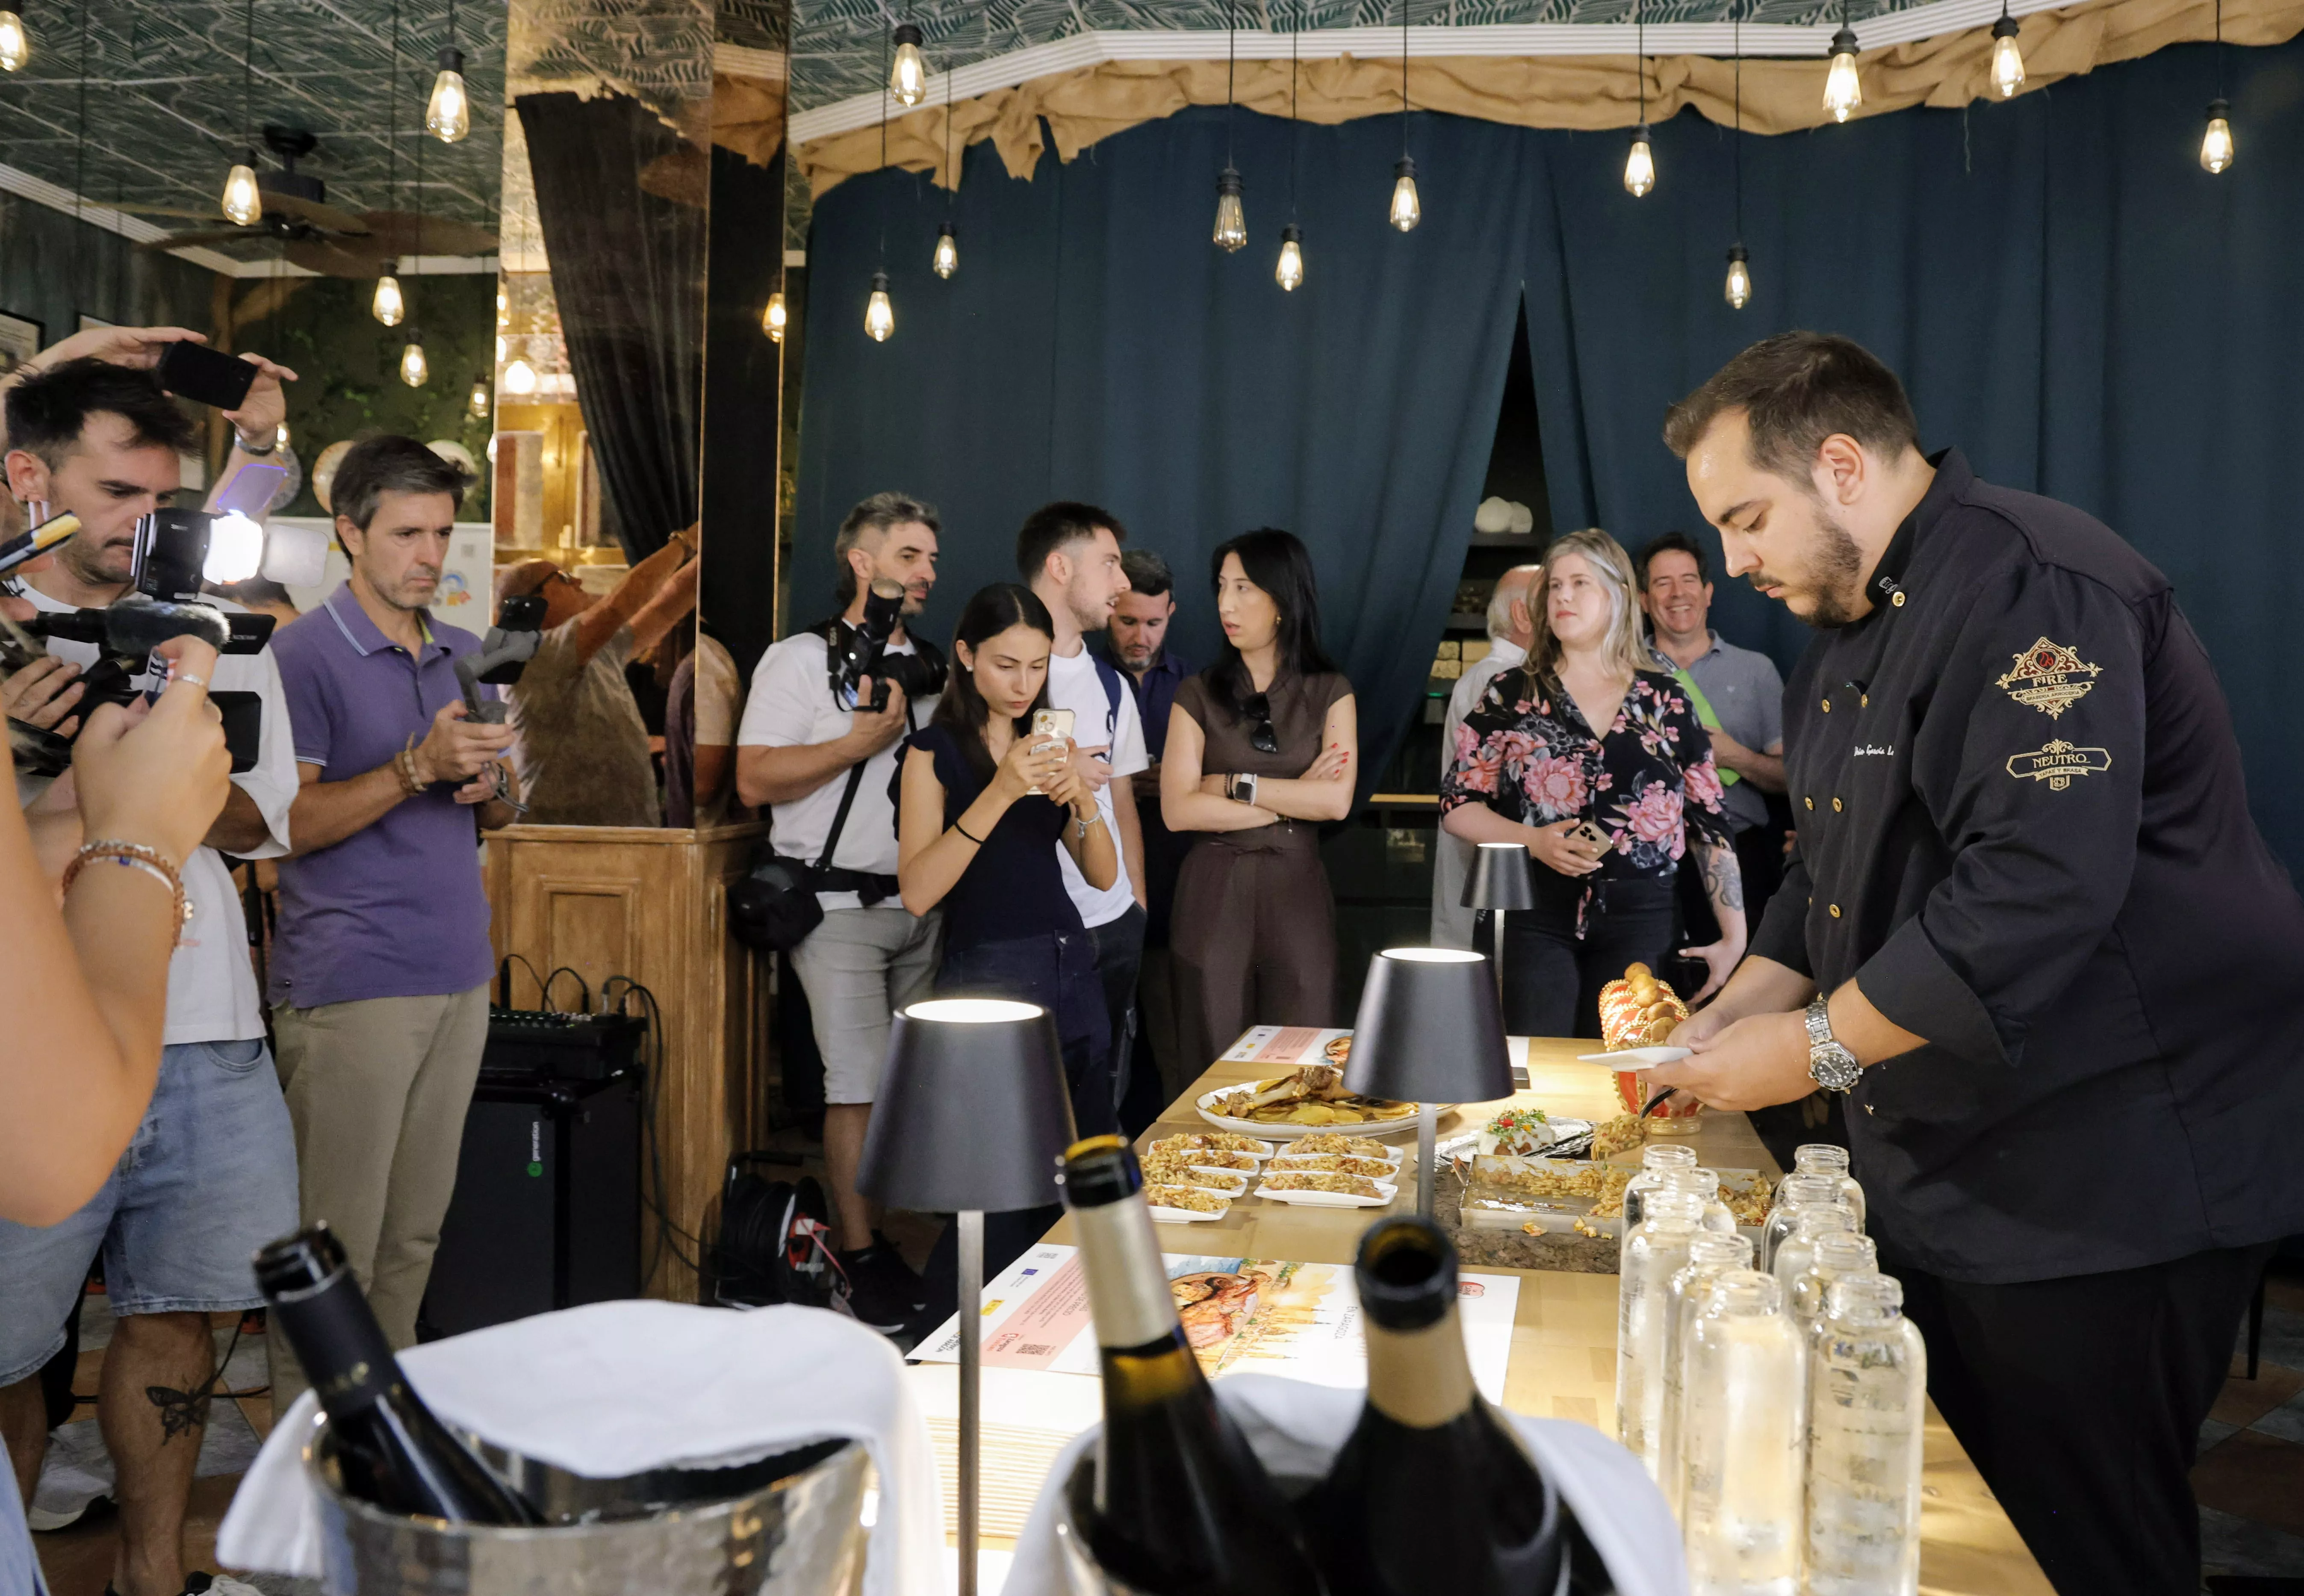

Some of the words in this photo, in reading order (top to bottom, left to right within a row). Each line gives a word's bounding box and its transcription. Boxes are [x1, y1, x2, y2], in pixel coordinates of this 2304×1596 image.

[2032, 674, 2068, 687] FIRE
[2032, 753, 2091, 768] NEUTRO
[2039, 769, 2055, 777] TAPAS
[1333, 1313, 1355, 1339] ZARAGOZA
[996, 1338, 1015, 1352] Zaragoza
